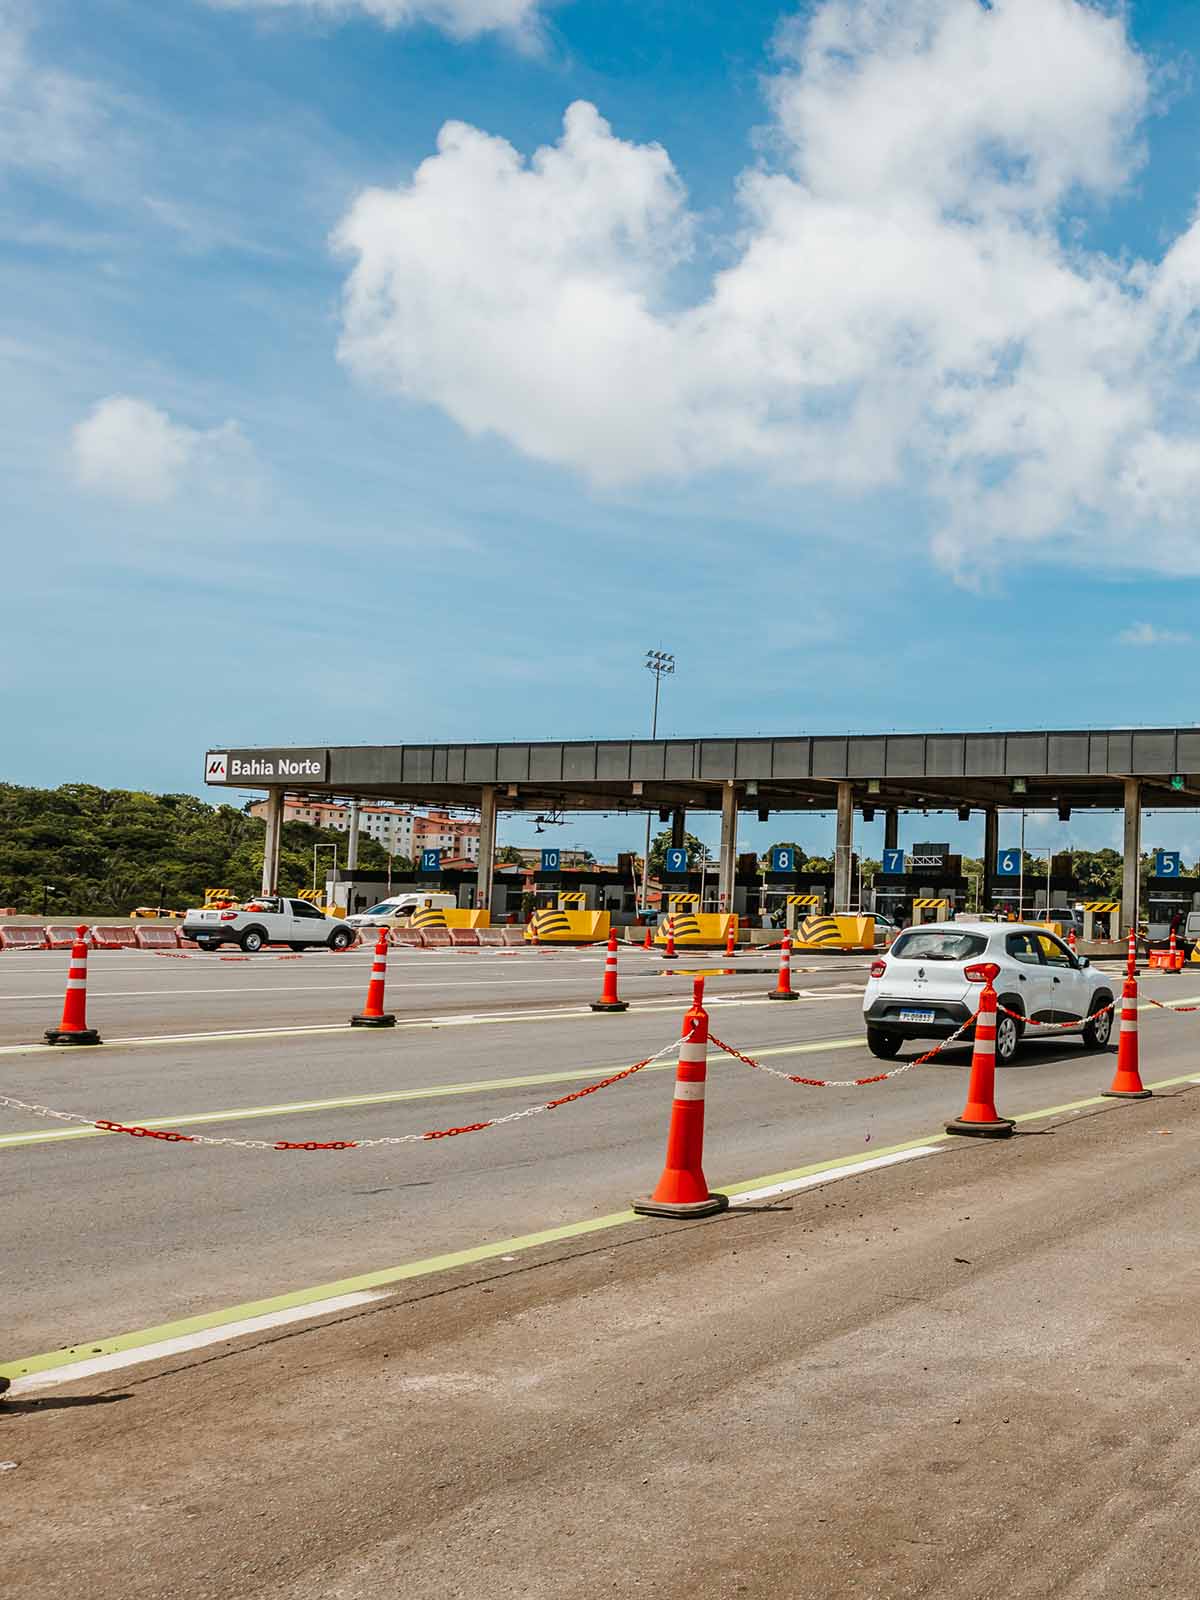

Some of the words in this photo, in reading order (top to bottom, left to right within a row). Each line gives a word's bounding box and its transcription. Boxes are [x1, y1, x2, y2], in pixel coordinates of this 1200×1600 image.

[231, 759, 274, 776] Bahia
[278, 759, 321, 775] Norte
[424, 853, 436, 866] 12
[545, 853, 557, 867] 10
[672, 852, 682, 868] 9
[779, 851, 788, 868] 8
[888, 853, 898, 870] 7
[1002, 854, 1013, 871] 6
[1163, 855, 1174, 873] 5
